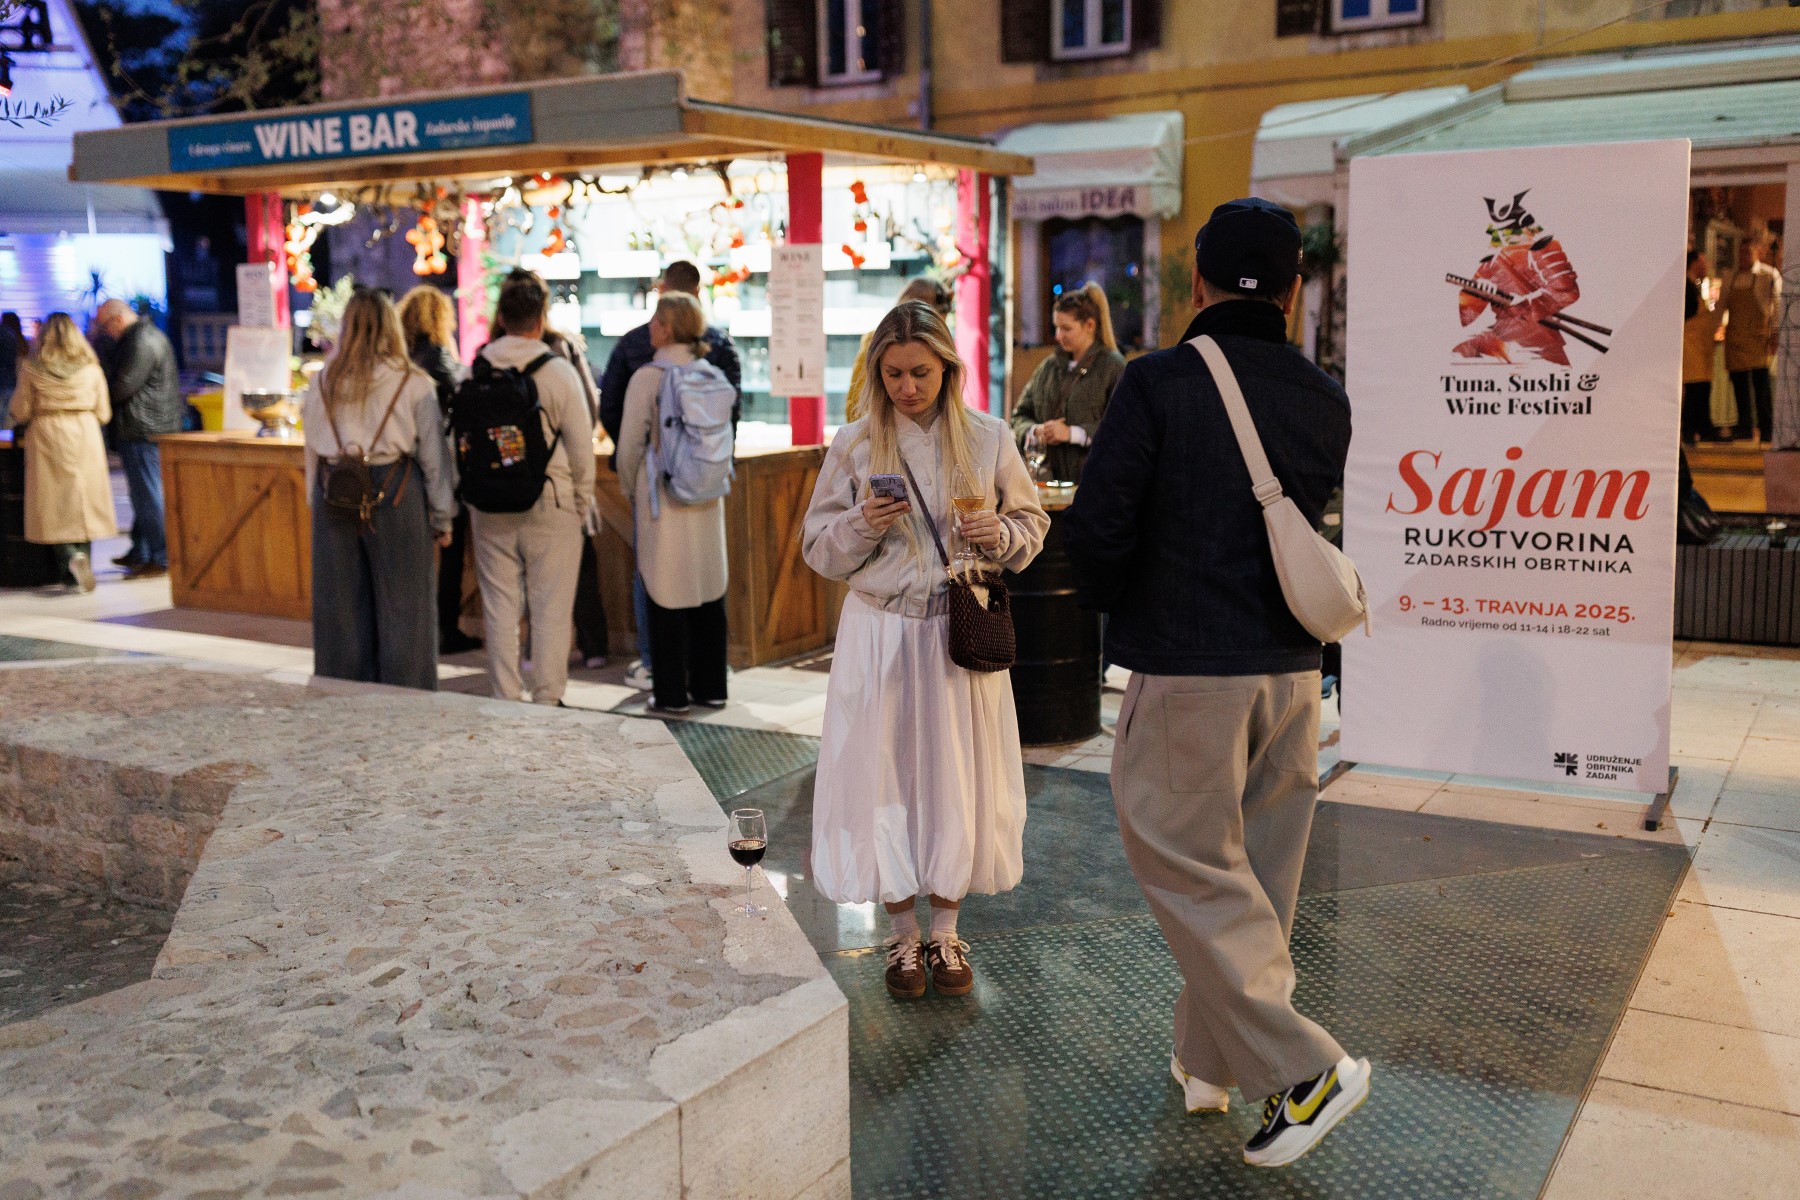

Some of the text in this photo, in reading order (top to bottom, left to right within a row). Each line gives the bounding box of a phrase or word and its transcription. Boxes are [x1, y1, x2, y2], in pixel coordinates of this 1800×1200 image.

[254, 110, 420, 160] WINE BAR
[1080, 186, 1136, 211] IDEA
[1440, 373, 1600, 395] Tuna, Sushi &
[1446, 396, 1593, 416] Wine Festival
[1385, 446, 1651, 533] Sajam
[1404, 527, 1635, 554] RUKOTVORINA
[1404, 552, 1632, 574] ZADARSKIH OBRTNIKA
[1399, 595, 1416, 612] 9.
[1441, 597, 1469, 615] 13.
[1475, 599, 1568, 617] TRAVNJA
[1574, 603, 1636, 624] 2025.
[1421, 616, 1456, 628] Radno
[1458, 618, 1500, 632] vrijeme
[1502, 621, 1517, 632] od
[1520, 624, 1549, 634] 11-14
[1557, 624, 1590, 636] 18-22
[1592, 627, 1611, 637] sat
[1586, 754, 1642, 766] UDRUŽENJE
[1586, 763, 1634, 774] OBRTNIKA
[1585, 771, 1617, 781] ZADAR
